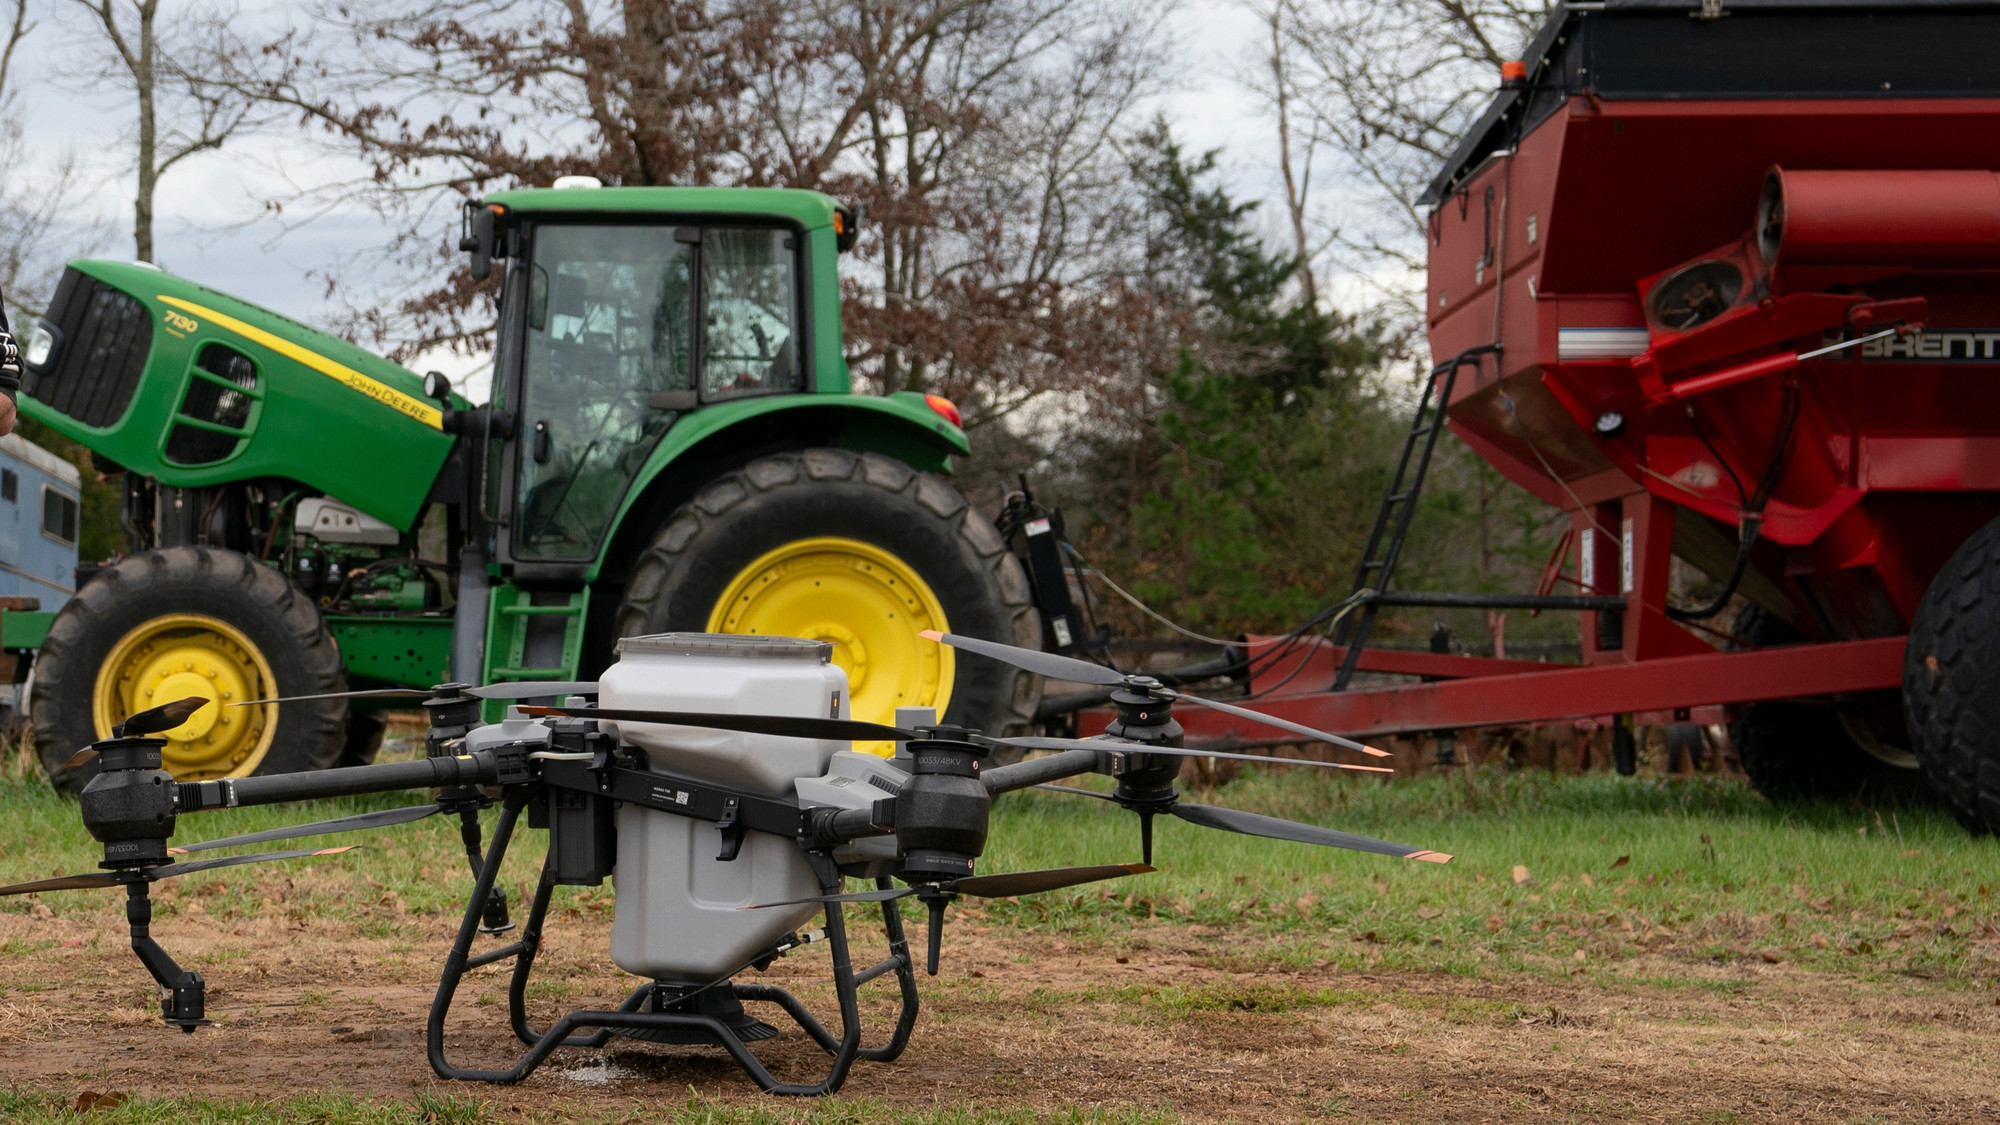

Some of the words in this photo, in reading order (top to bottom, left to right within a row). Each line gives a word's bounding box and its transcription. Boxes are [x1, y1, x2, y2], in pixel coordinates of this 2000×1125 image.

[163, 310, 198, 333] 7130
[1860, 331, 2000, 359] BRENT
[344, 373, 381, 397] JOHN
[381, 389, 429, 420] DEERE
